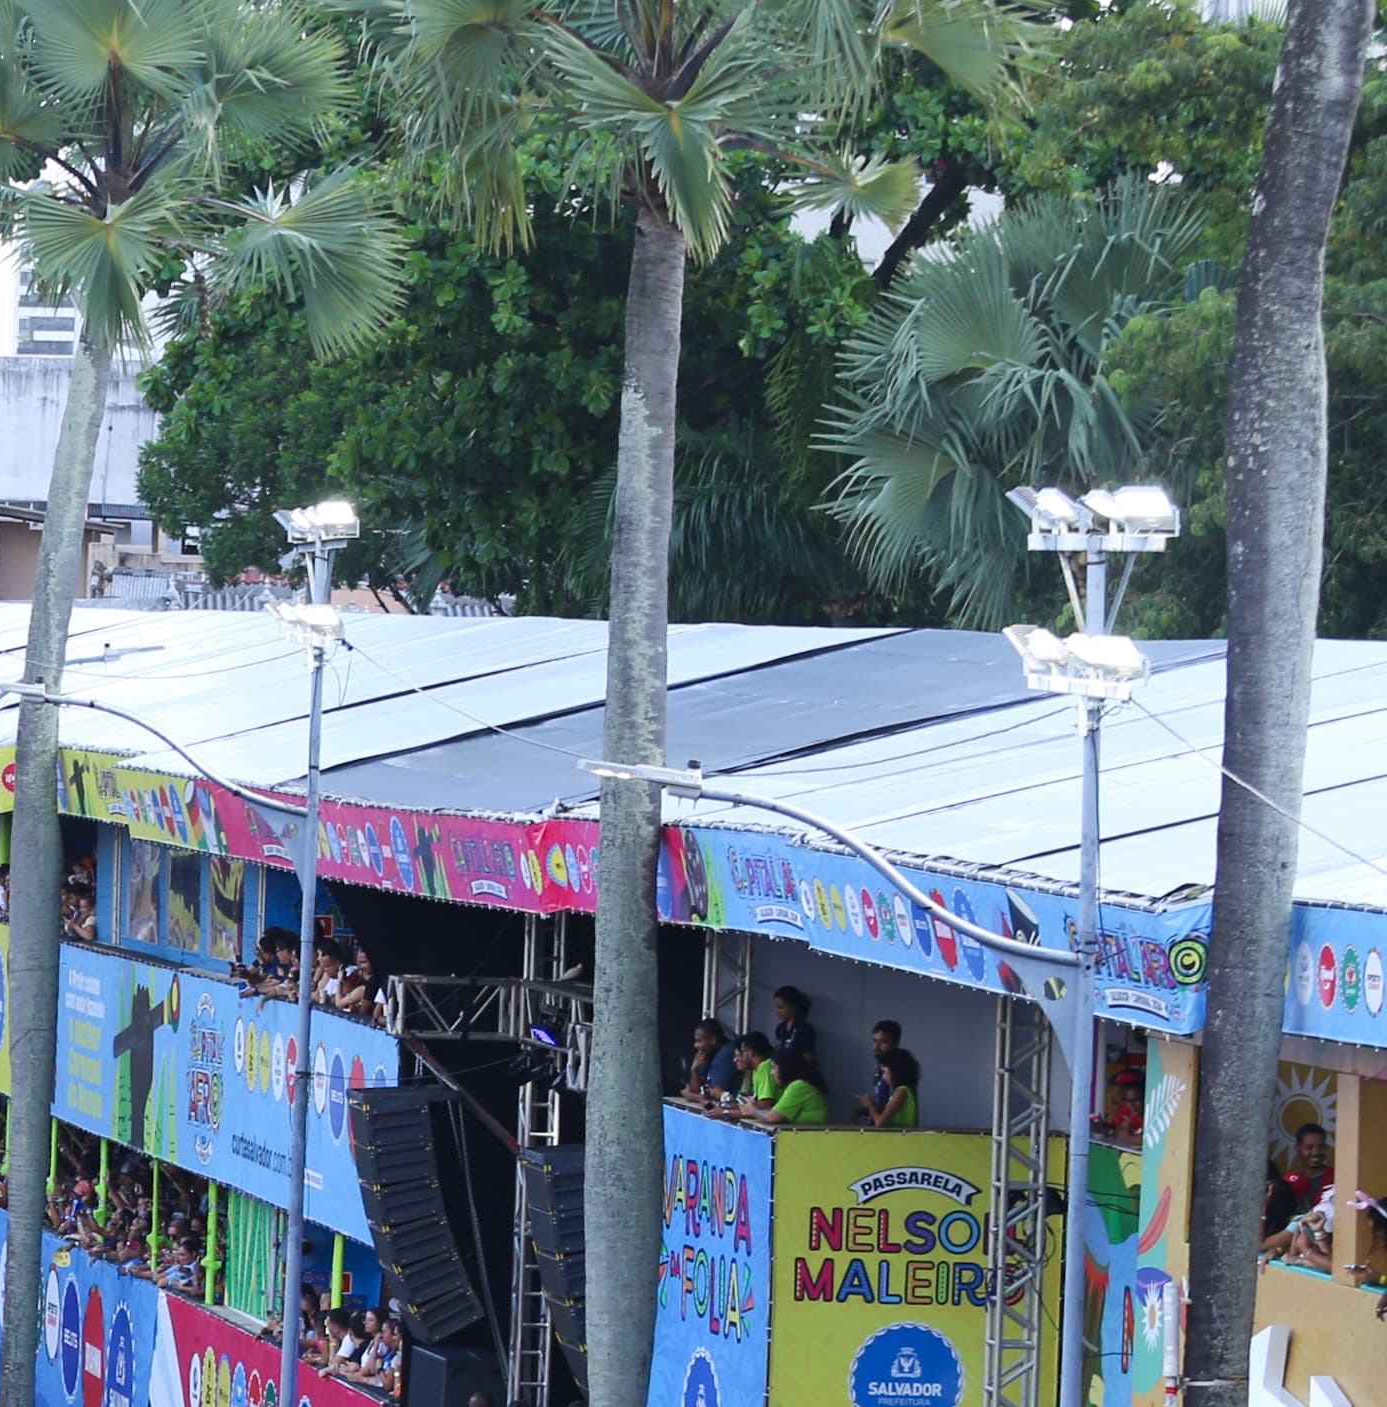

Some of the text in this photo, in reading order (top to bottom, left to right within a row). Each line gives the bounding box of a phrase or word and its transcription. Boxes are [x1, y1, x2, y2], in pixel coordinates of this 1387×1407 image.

[860, 1170, 964, 1198] PASSARELA
[662, 1154, 752, 1256] VARANDA
[681, 1243, 743, 1344] FOLIA
[867, 1381, 942, 1398] SALVADOR
[877, 1397, 931, 1407] PREFEITURA
